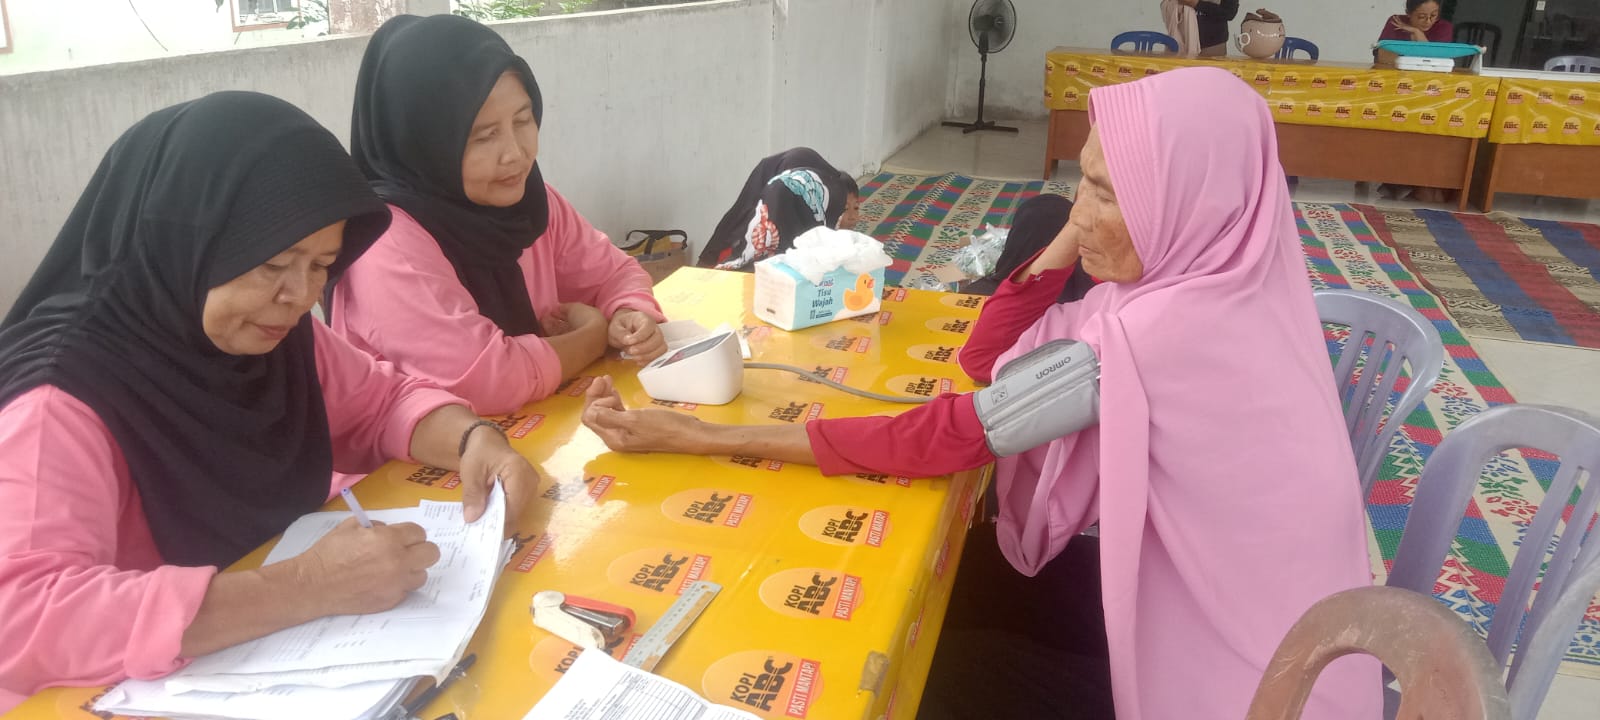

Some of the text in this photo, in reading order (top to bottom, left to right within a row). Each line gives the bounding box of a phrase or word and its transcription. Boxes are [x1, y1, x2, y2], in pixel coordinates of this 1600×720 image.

[811, 296, 833, 308] Wajah
[817, 288, 832, 297] Tisu
[933, 346, 954, 363] ABC
[914, 377, 938, 397] ABC
[779, 401, 809, 423] ABC
[683, 500, 705, 519] KOPI
[694, 493, 733, 524] ABC
[821, 518, 841, 538] KOPI
[833, 510, 869, 543] ABC
[629, 563, 656, 587] KOPI
[642, 554, 689, 592] ABC
[783, 585, 806, 609] KOPI
[797, 574, 837, 616] ABC
[835, 599, 853, 619] PASTI
[730, 672, 757, 703] KOPI
[745, 659, 794, 712] ABC
[788, 692, 809, 716] PASTI
